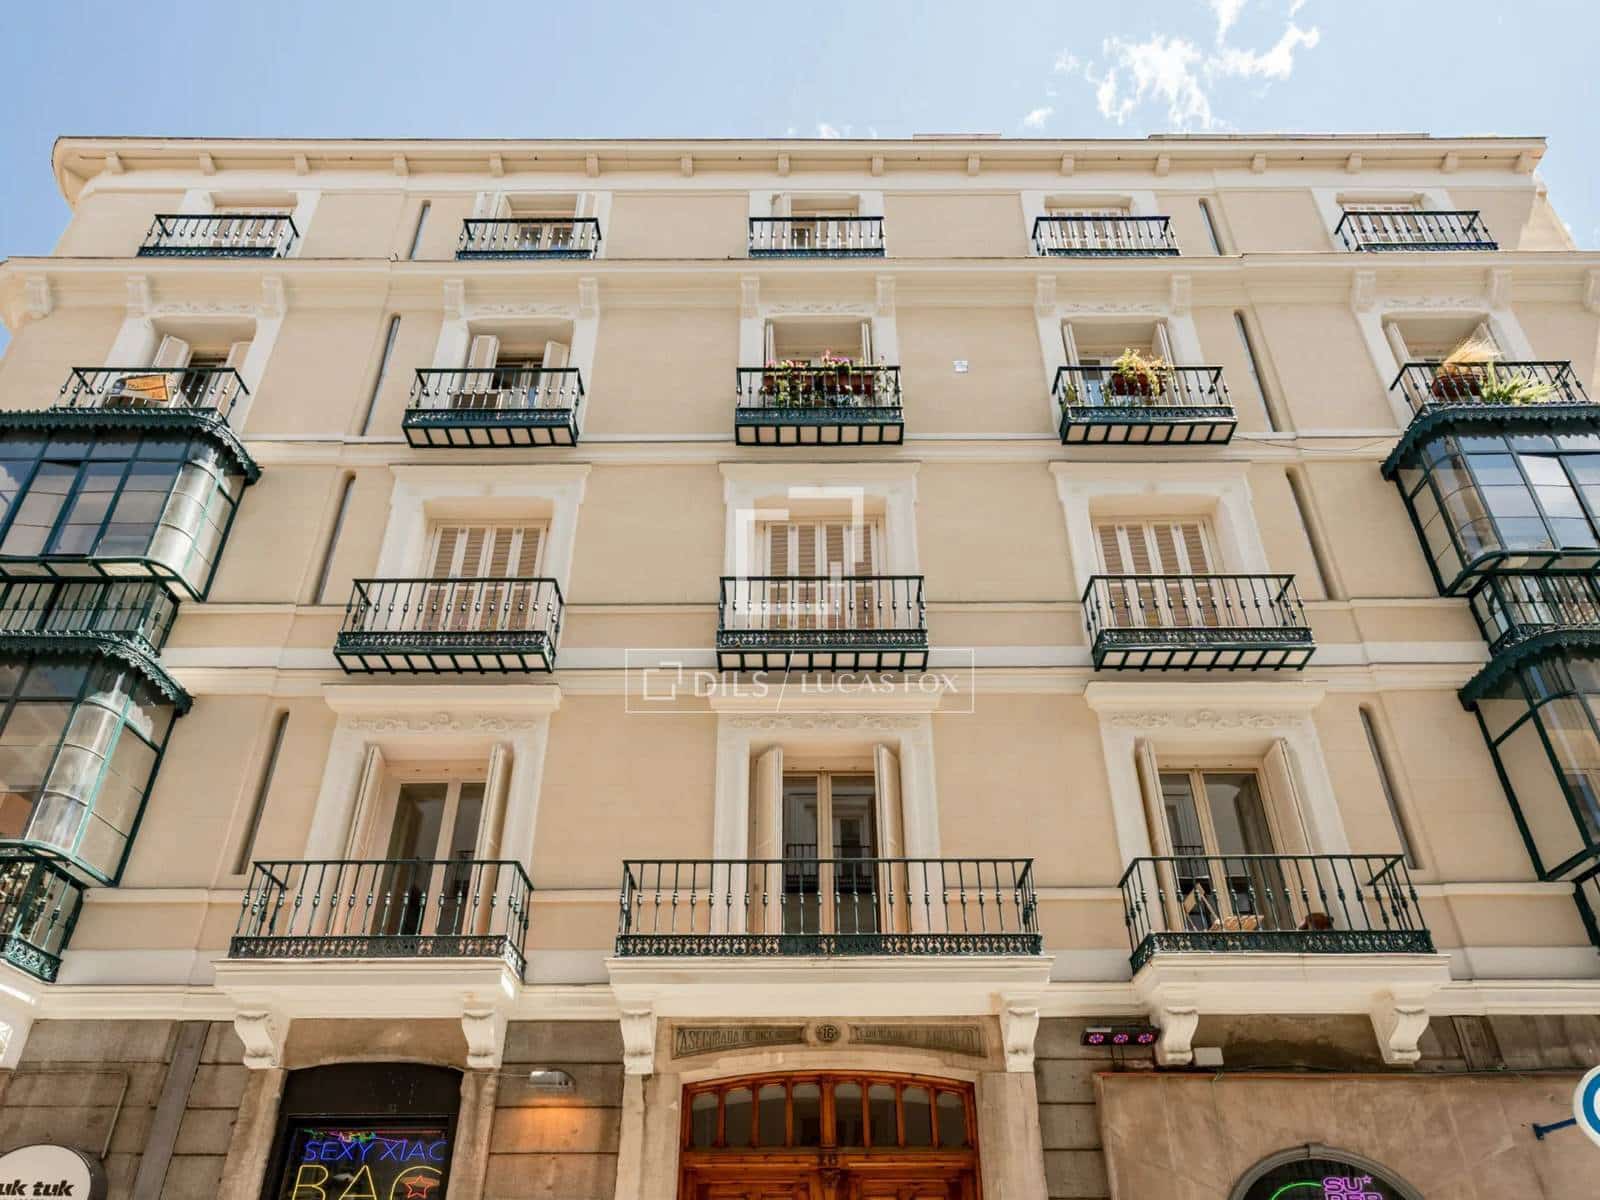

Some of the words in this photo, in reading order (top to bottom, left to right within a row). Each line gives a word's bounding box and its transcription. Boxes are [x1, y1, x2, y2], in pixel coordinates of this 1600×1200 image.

[823, 1028, 834, 1039] 16
[303, 1141, 376, 1161] SEXY
[33, 1179, 74, 1196] tuk
